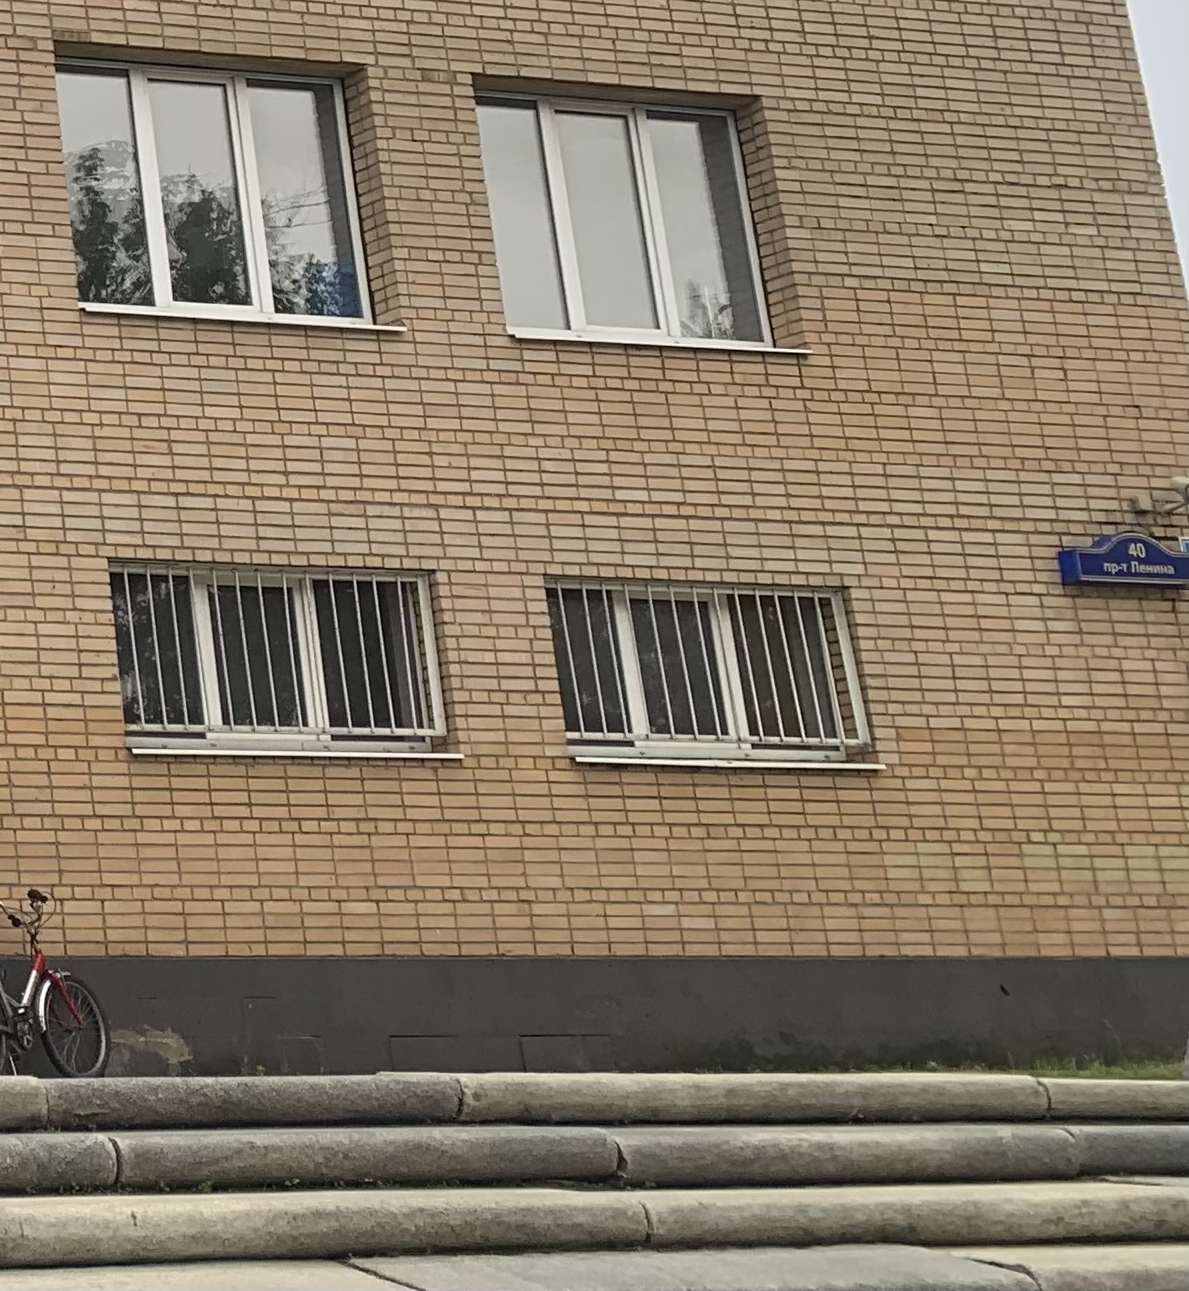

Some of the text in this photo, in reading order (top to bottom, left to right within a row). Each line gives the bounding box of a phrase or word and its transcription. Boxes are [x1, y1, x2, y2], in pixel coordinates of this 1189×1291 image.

[1128, 542, 1146, 559] 40
[1103, 560, 1175, 575] пр-т Ленина
